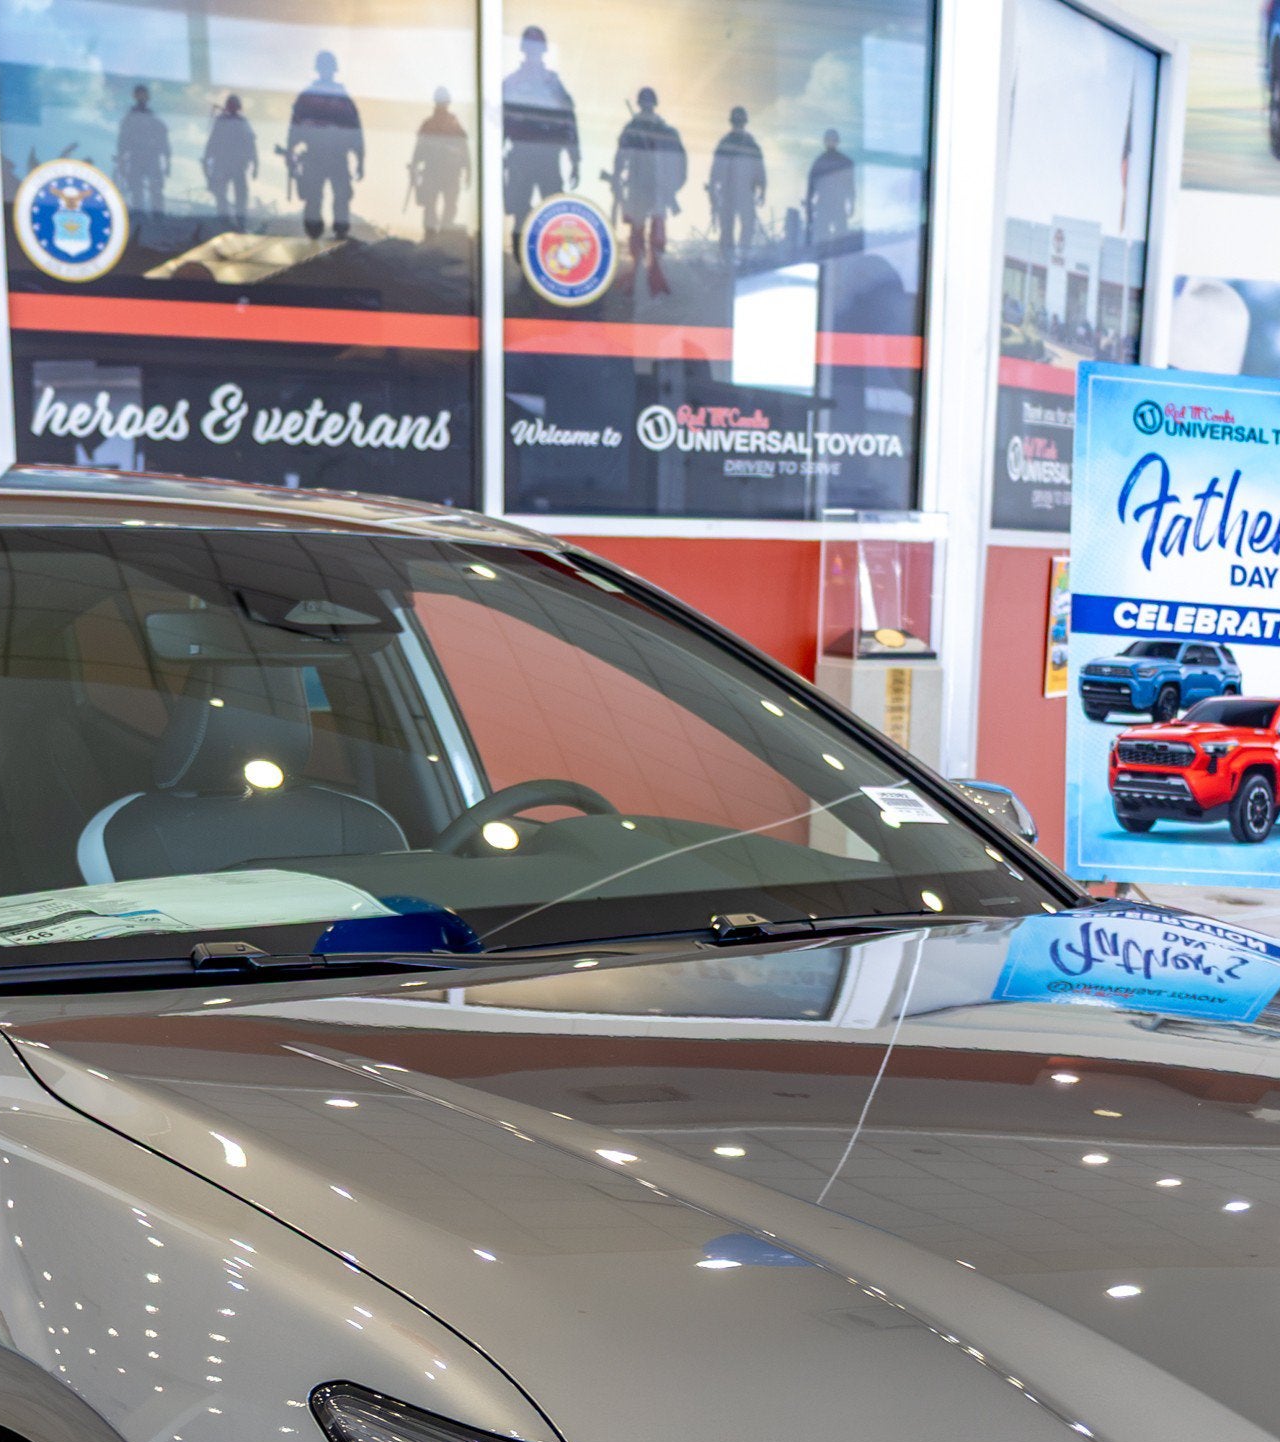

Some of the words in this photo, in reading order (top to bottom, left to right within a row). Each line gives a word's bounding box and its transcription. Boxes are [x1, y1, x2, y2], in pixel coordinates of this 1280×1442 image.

[30, 386, 190, 442] heroes
[201, 382, 249, 444] &
[251, 398, 452, 451] veterans
[510, 417, 600, 447] Welcome
[601, 426, 623, 447] to
[676, 427, 813, 455] UNIVERSAL
[814, 432, 904, 457] TOYOTA
[1164, 420, 1269, 445] UNIVERSAL
[724, 459, 775, 475] DRIVEN
[777, 461, 798, 475] TO
[800, 461, 842, 476] SERVE
[1230, 564, 1280, 589] DAY
